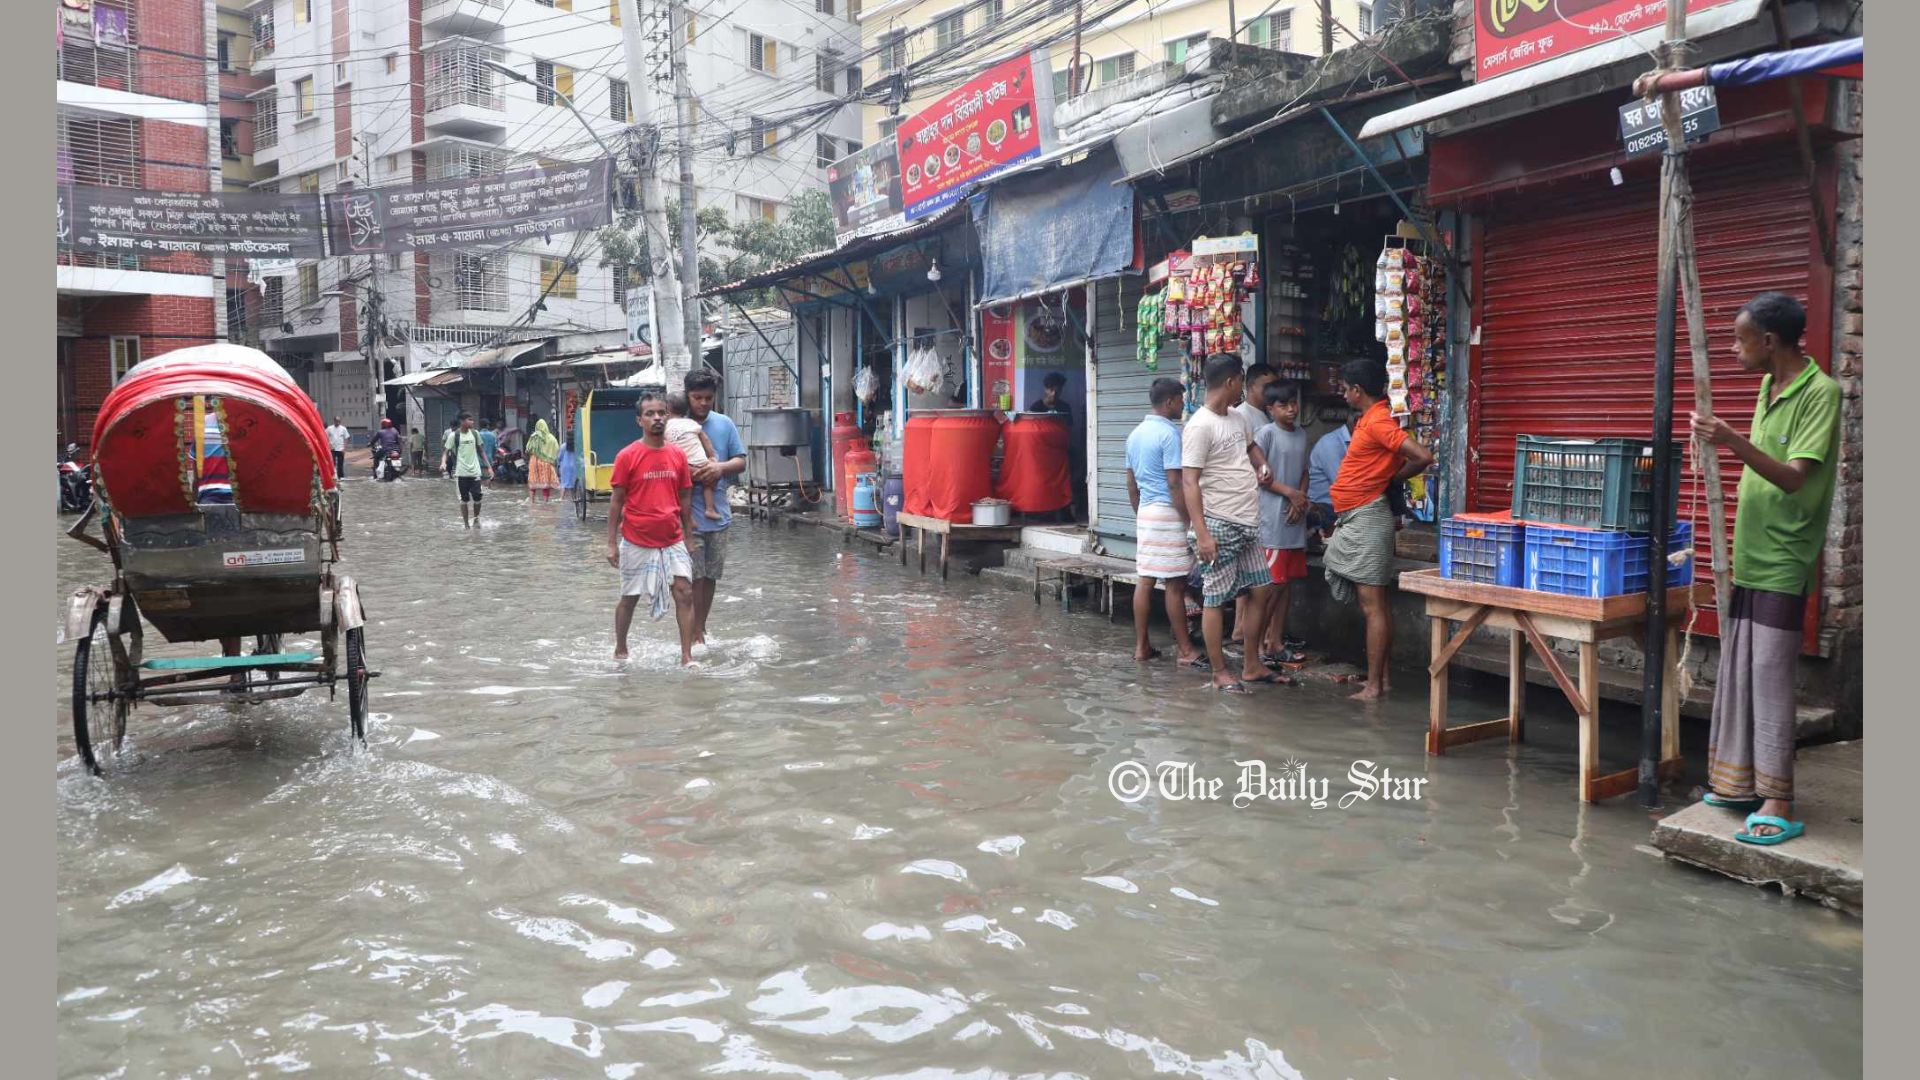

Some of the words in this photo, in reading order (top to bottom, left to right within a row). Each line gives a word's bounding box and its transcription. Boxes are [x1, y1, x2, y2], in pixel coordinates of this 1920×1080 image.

[1483, 45, 1508, 70] মেসার্স
[1509, 40, 1536, 61] জেরিন
[1537, 34, 1554, 54] ফুড
[915, 121, 939, 145] আল্লাহর
[940, 113, 954, 129] দান
[954, 90, 984, 121] বিরিয়ানী
[984, 80, 1007, 106] হাউজ
[1623, 107, 1643, 128] ঘর
[1627, 117, 1699, 153] 018258335
[513, 217, 566, 235] ফাউন্ডেশন
[229, 240, 290, 253] ফাউন্ডেশন
